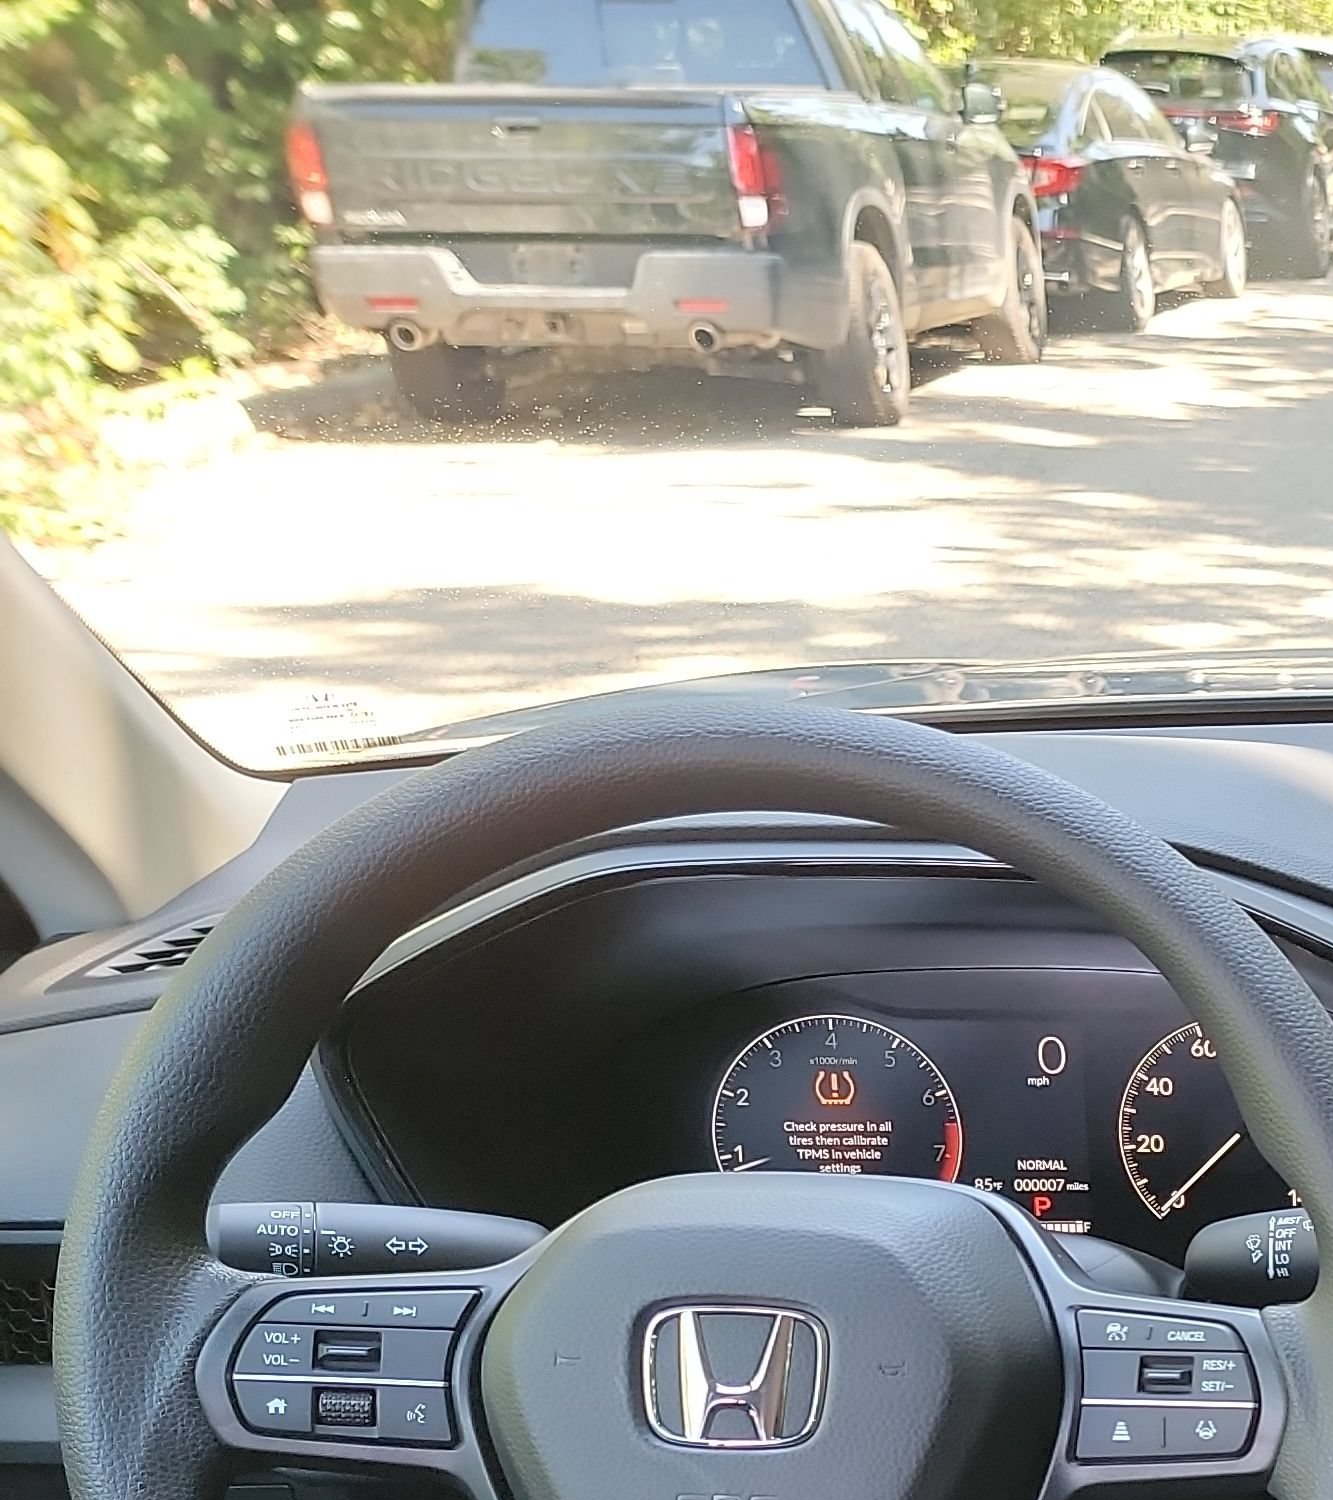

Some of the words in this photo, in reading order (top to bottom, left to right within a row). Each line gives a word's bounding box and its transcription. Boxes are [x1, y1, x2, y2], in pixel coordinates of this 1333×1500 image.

[824, 1033, 837, 1049] 4
[770, 1051, 782, 1068] 3
[884, 1051, 896, 1068] 5
[1038, 1036, 1067, 1075] 0
[1027, 1076, 1050, 1087] mph
[1146, 1077, 1173, 1096] 40
[736, 1088, 750, 1106] 2
[922, 1089, 934, 1106] 6
[783, 1121, 817, 1133] Check
[819, 1123, 865, 1135] pressure
[867, 1121, 877, 1132] in
[879, 1121, 893, 1132] all
[789, 1136, 813, 1146] tires
[815, 1136, 841, 1146] then
[842, 1135, 889, 1146] calibrate
[1137, 1135, 1165, 1153] 20
[733, 1145, 743, 1162] 1
[796, 1149, 829, 1160] TPMS
[831, 1149, 842, 1160] in
[843, 1149, 881, 1160] vehicle
[933, 1145, 946, 1162] 7
[819, 1163, 862, 1174] settings
[1017, 1160, 1067, 1171] NORMAL
[1014, 1179, 1065, 1192] 000007
[1066, 1182, 1089, 1191] miles
[1034, 1197, 1051, 1217] P
[271, 1210, 300, 1219] OFF
[1277, 1216, 1302, 1226] MIST
[257, 1225, 299, 1237] AUTO
[1084, 1223, 1092, 1233] F
[1276, 1228, 1296, 1238] OFF
[1275, 1240, 1293, 1251] INT
[1275, 1254, 1289, 1265] LO
[1276, 1267, 1290, 1277] HI
[1167, 1331, 1206, 1342] CANCEL
